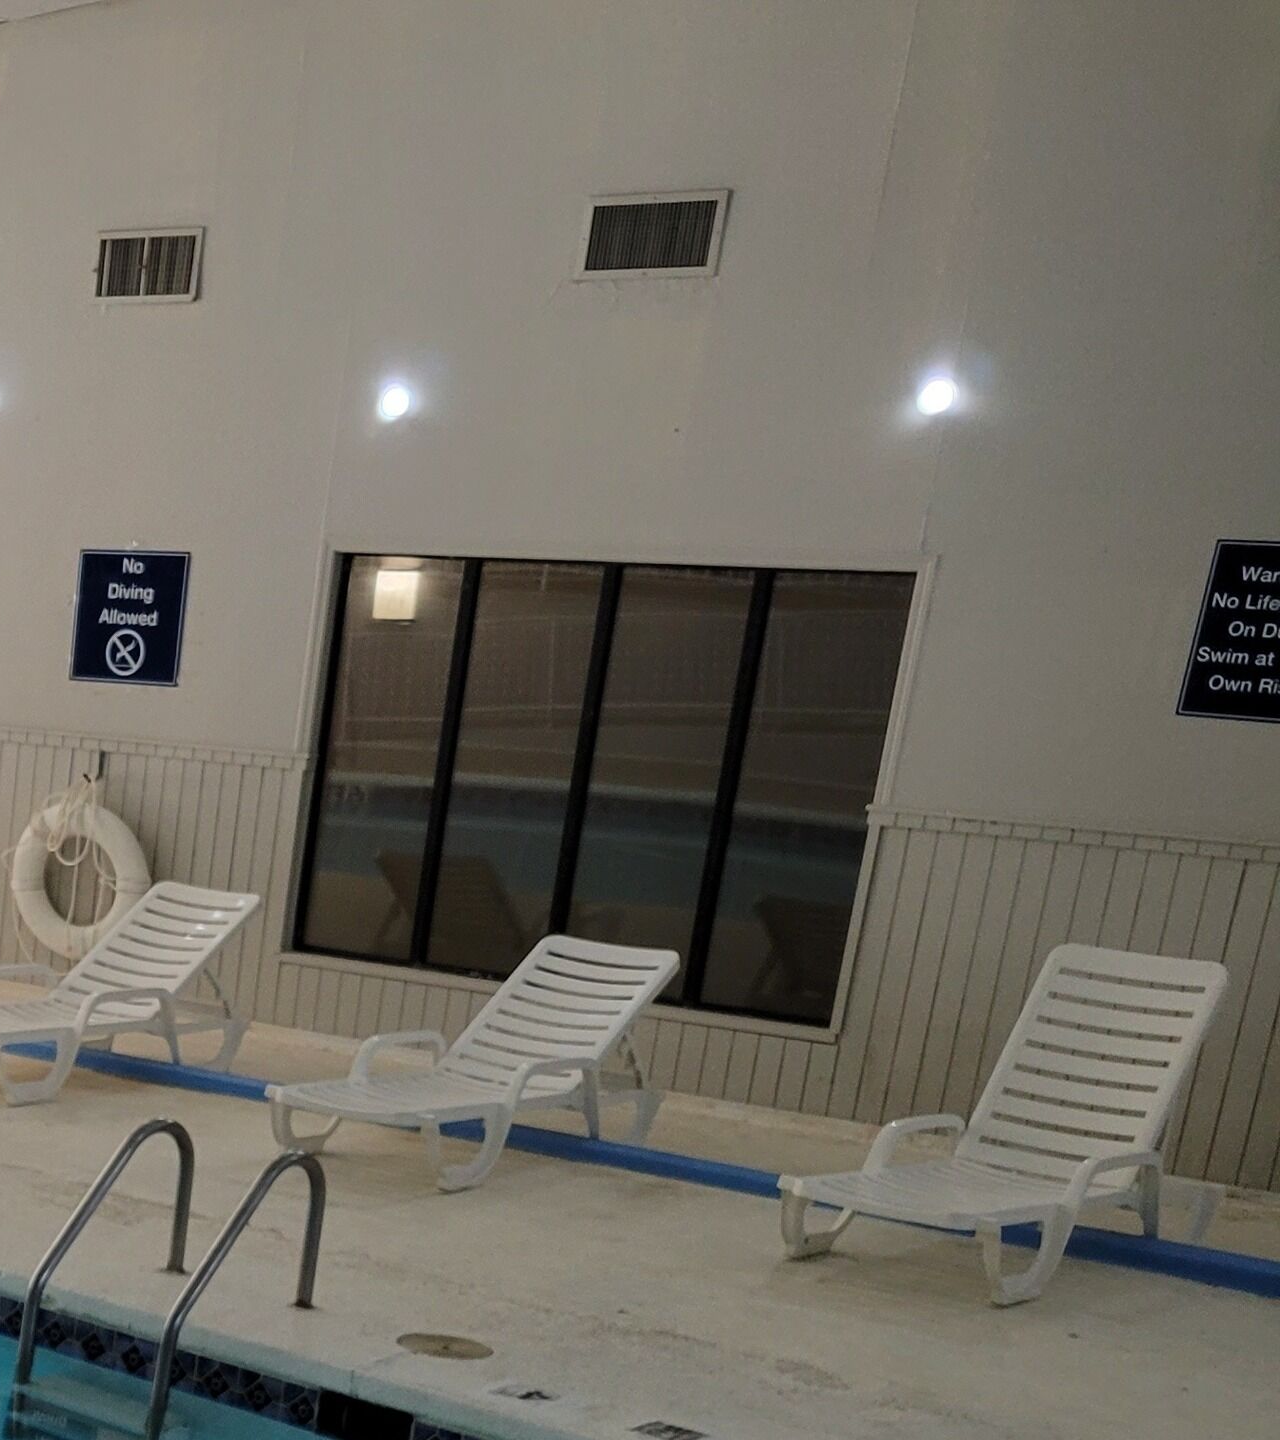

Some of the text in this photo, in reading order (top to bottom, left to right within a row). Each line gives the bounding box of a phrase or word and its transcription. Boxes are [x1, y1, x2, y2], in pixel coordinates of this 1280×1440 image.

[122, 557, 145, 574] No
[107, 582, 155, 604] Diving
[1212, 592, 1240, 609] No
[98, 607, 158, 627] Allowed
[1228, 621, 1280, 639] On D
[1196, 646, 1276, 666] Swim at
[1208, 674, 1252, 692] Own
